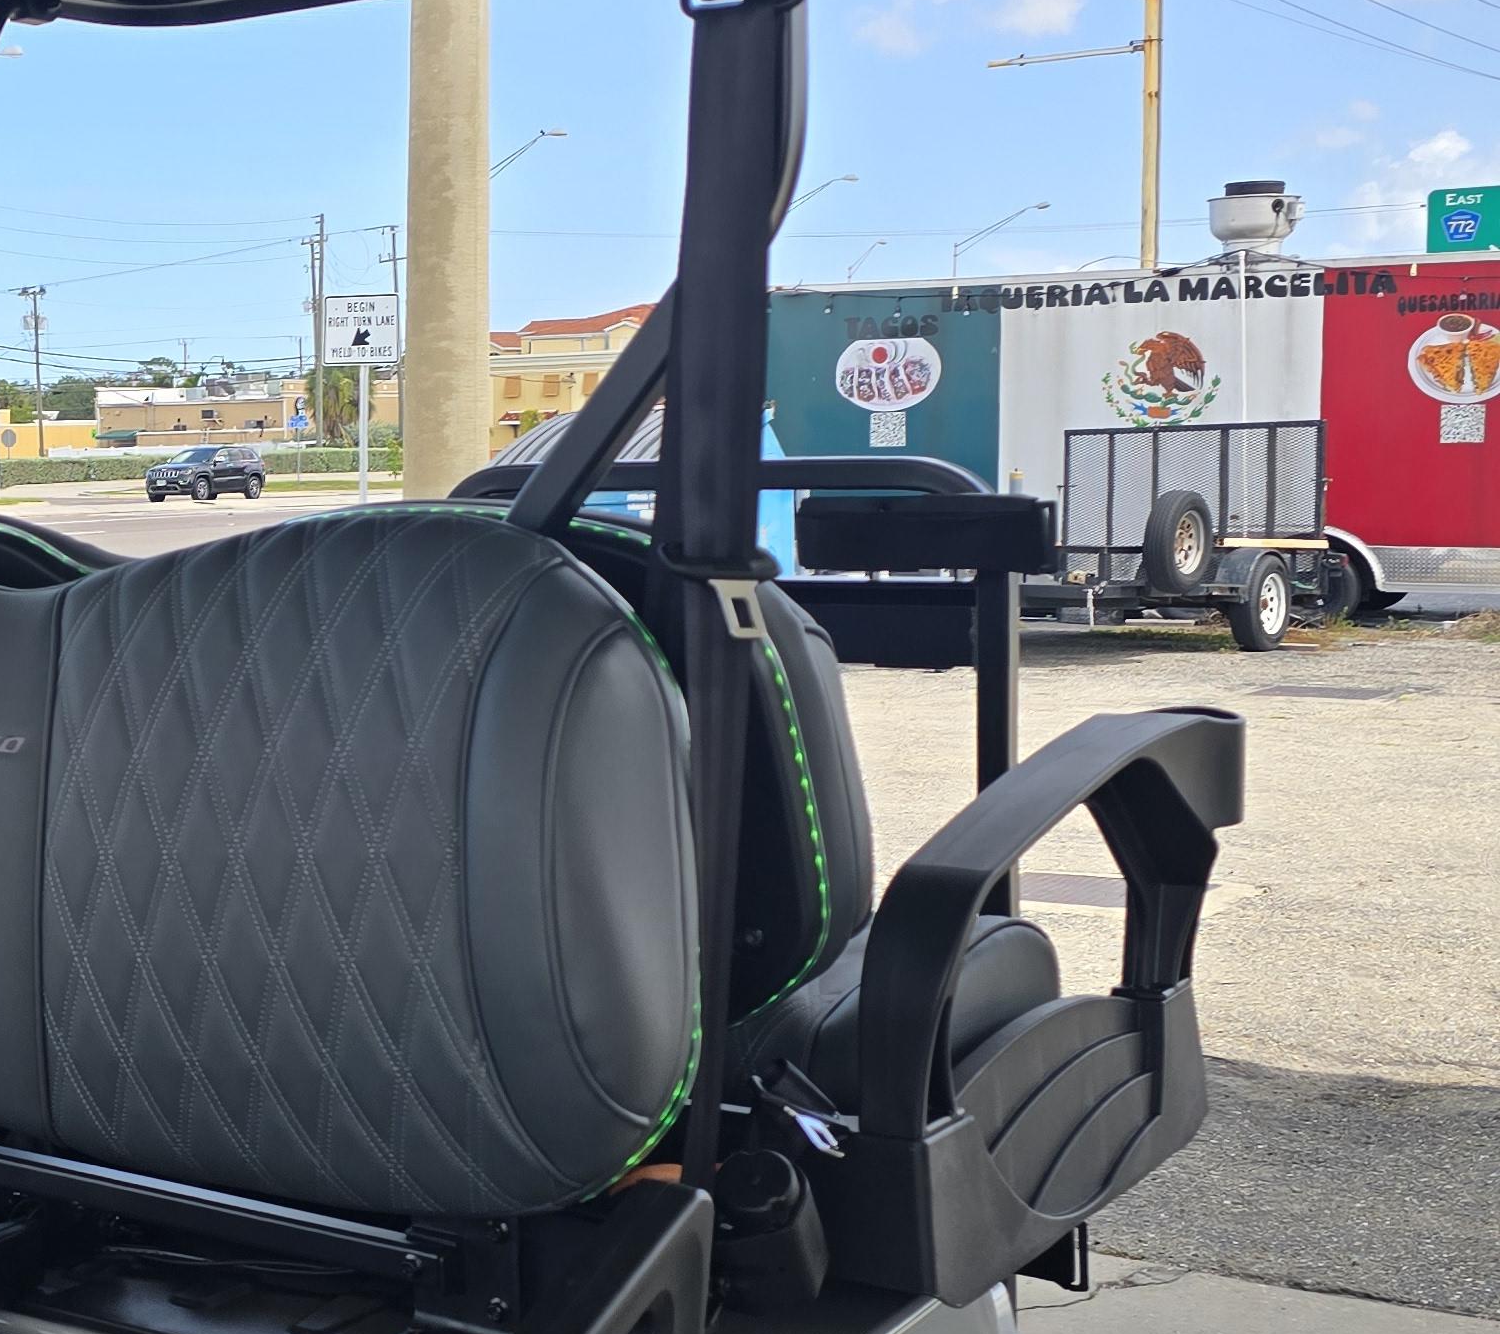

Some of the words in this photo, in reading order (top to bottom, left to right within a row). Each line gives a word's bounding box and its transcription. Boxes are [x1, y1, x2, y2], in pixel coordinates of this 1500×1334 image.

[1445, 193, 1484, 206] EAST
[1447, 220, 1475, 233] 772
[938, 281, 1110, 314] TAQUERIA
[1124, 279, 1170, 304] LA
[1178, 269, 1398, 302] MARCELITA
[347, 301, 375, 313] BEGIN
[328, 316, 349, 328] RIGHT
[353, 315, 372, 327] TURN
[375, 315, 395, 326] LANE
[844, 314, 939, 340] TACOS
[331, 347, 352, 358] YIELD
[357, 346, 366, 357] TO
[369, 346, 393, 357] BIKES
